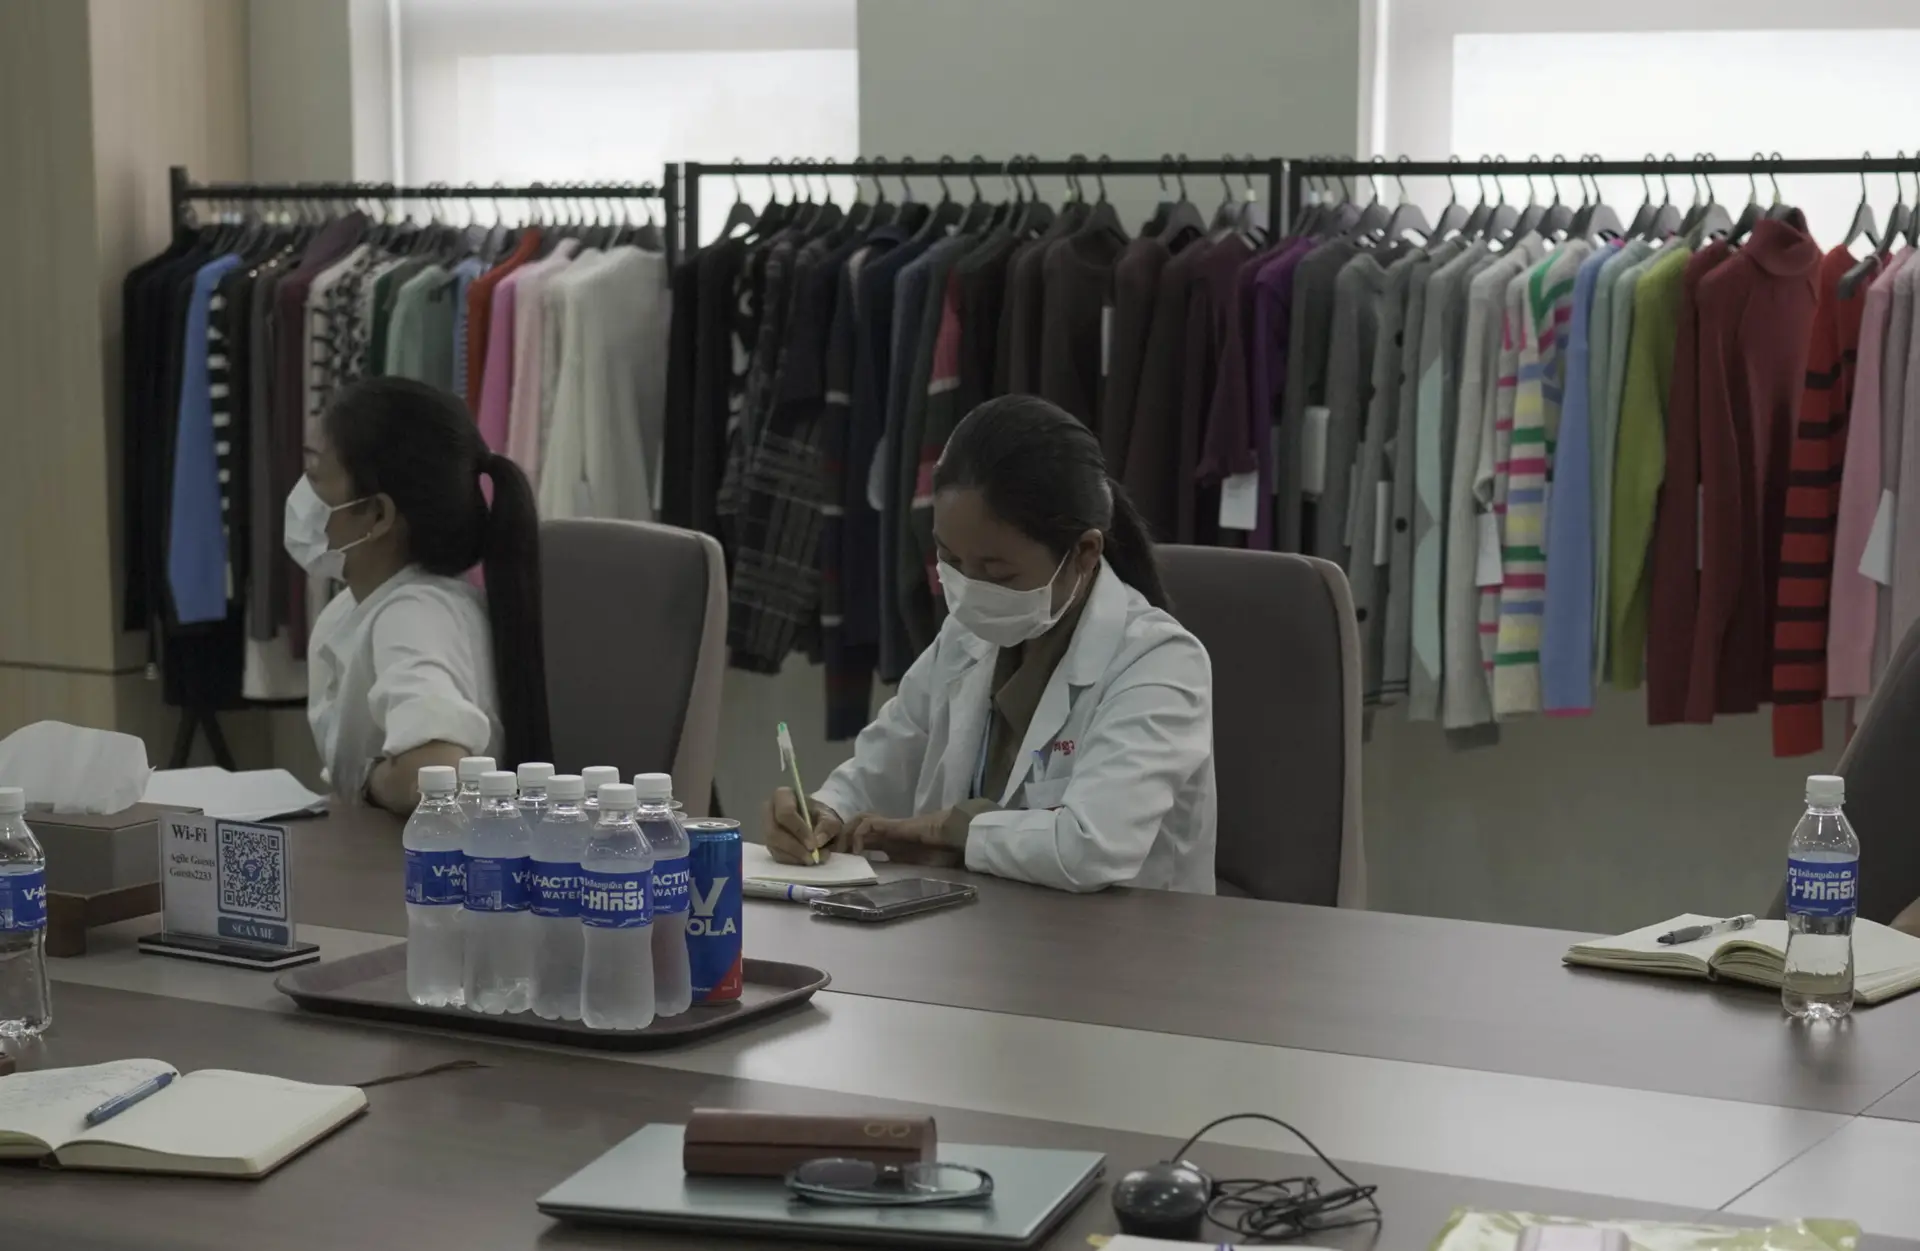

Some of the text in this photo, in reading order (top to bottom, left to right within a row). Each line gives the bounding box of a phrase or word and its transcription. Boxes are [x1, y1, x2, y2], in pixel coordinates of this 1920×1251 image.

[172, 824, 208, 843] Wi-Fi
[190, 855, 215, 867] Guests
[432, 864, 465, 877] V-AC
[652, 869, 690, 886] ACTIV
[22, 884, 46, 901] V-AC
[652, 885, 688, 897] WATER
[689, 877, 730, 917] V
[231, 923, 275, 940] SCAN ME
[686, 917, 737, 936] OLA
